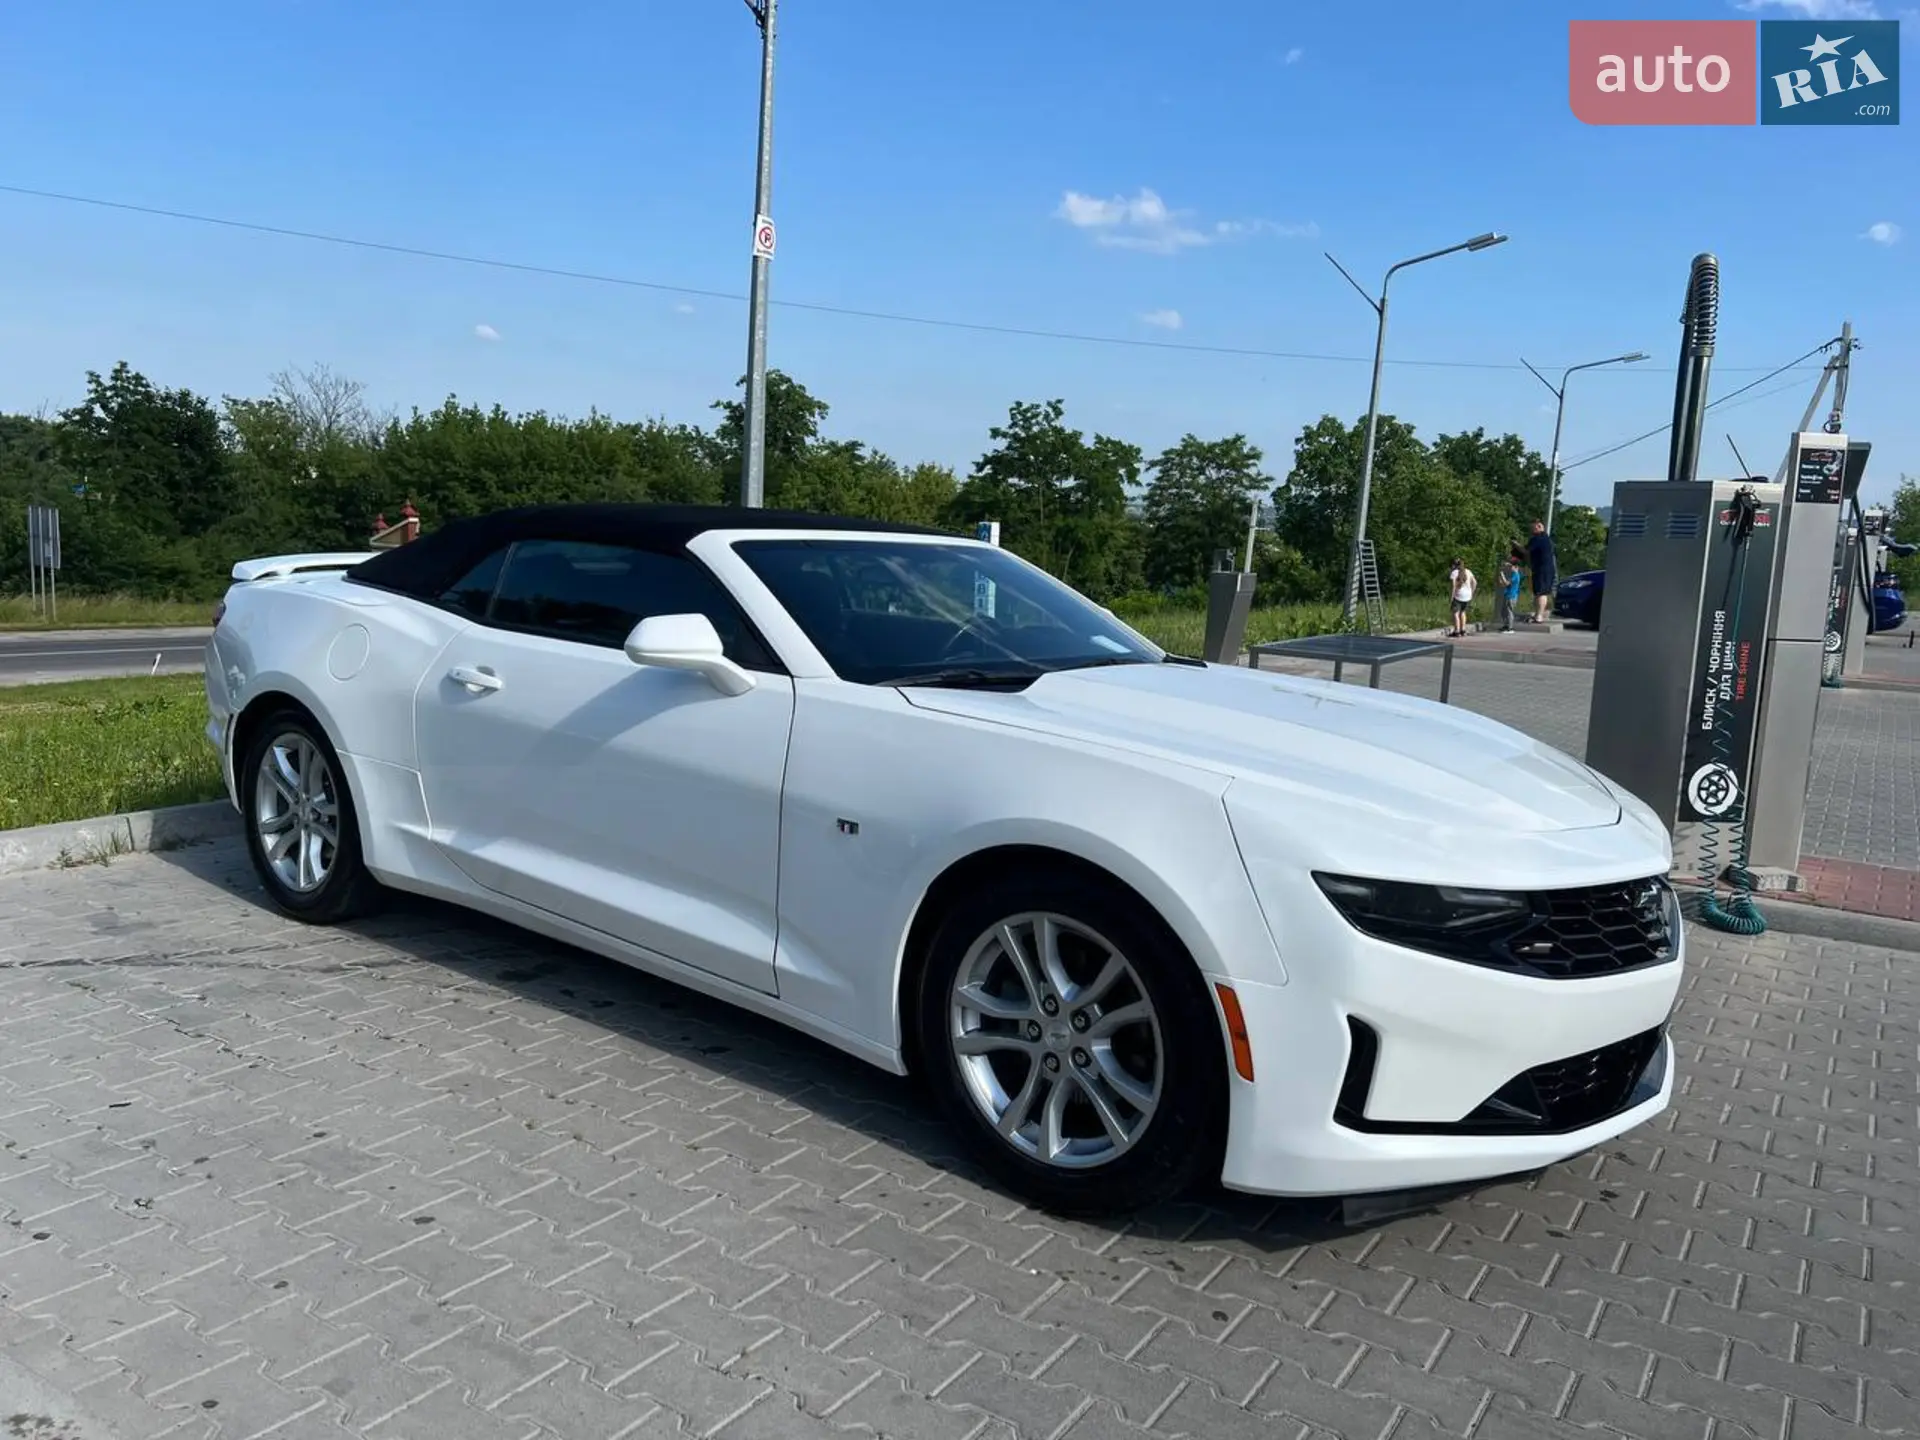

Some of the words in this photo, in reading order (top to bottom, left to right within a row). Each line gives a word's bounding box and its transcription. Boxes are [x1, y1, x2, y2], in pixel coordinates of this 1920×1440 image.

[1708, 610, 1725, 673] ЧОРНІННЯ
[1739, 641, 1751, 675] SHINE
[1720, 674, 1732, 701] ДЛЯ
[1702, 688, 1717, 730] БЛИСК
